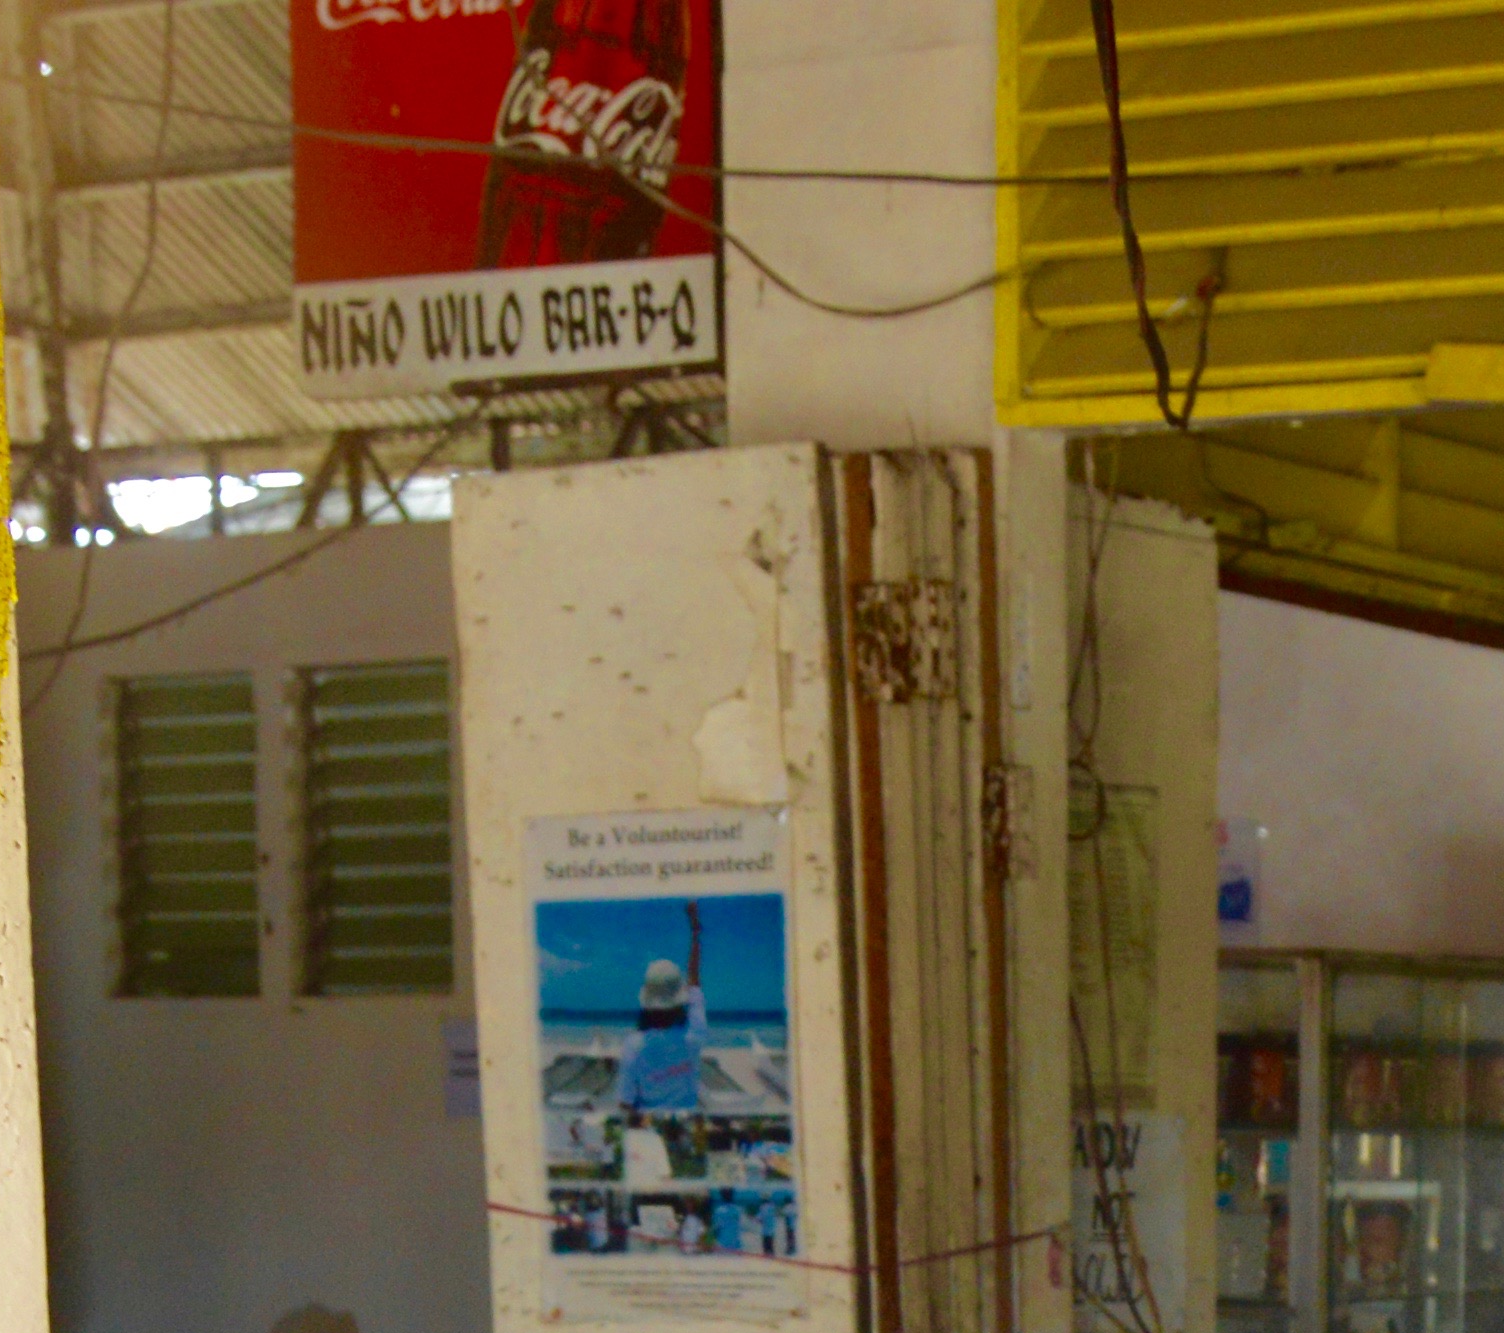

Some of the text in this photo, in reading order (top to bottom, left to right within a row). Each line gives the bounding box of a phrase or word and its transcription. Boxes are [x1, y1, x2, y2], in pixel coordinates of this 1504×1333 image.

[422, 291, 523, 363] WILO
[567, 827, 591, 848] Be
[544, 850, 774, 883] Satisfaction guaranteed!
